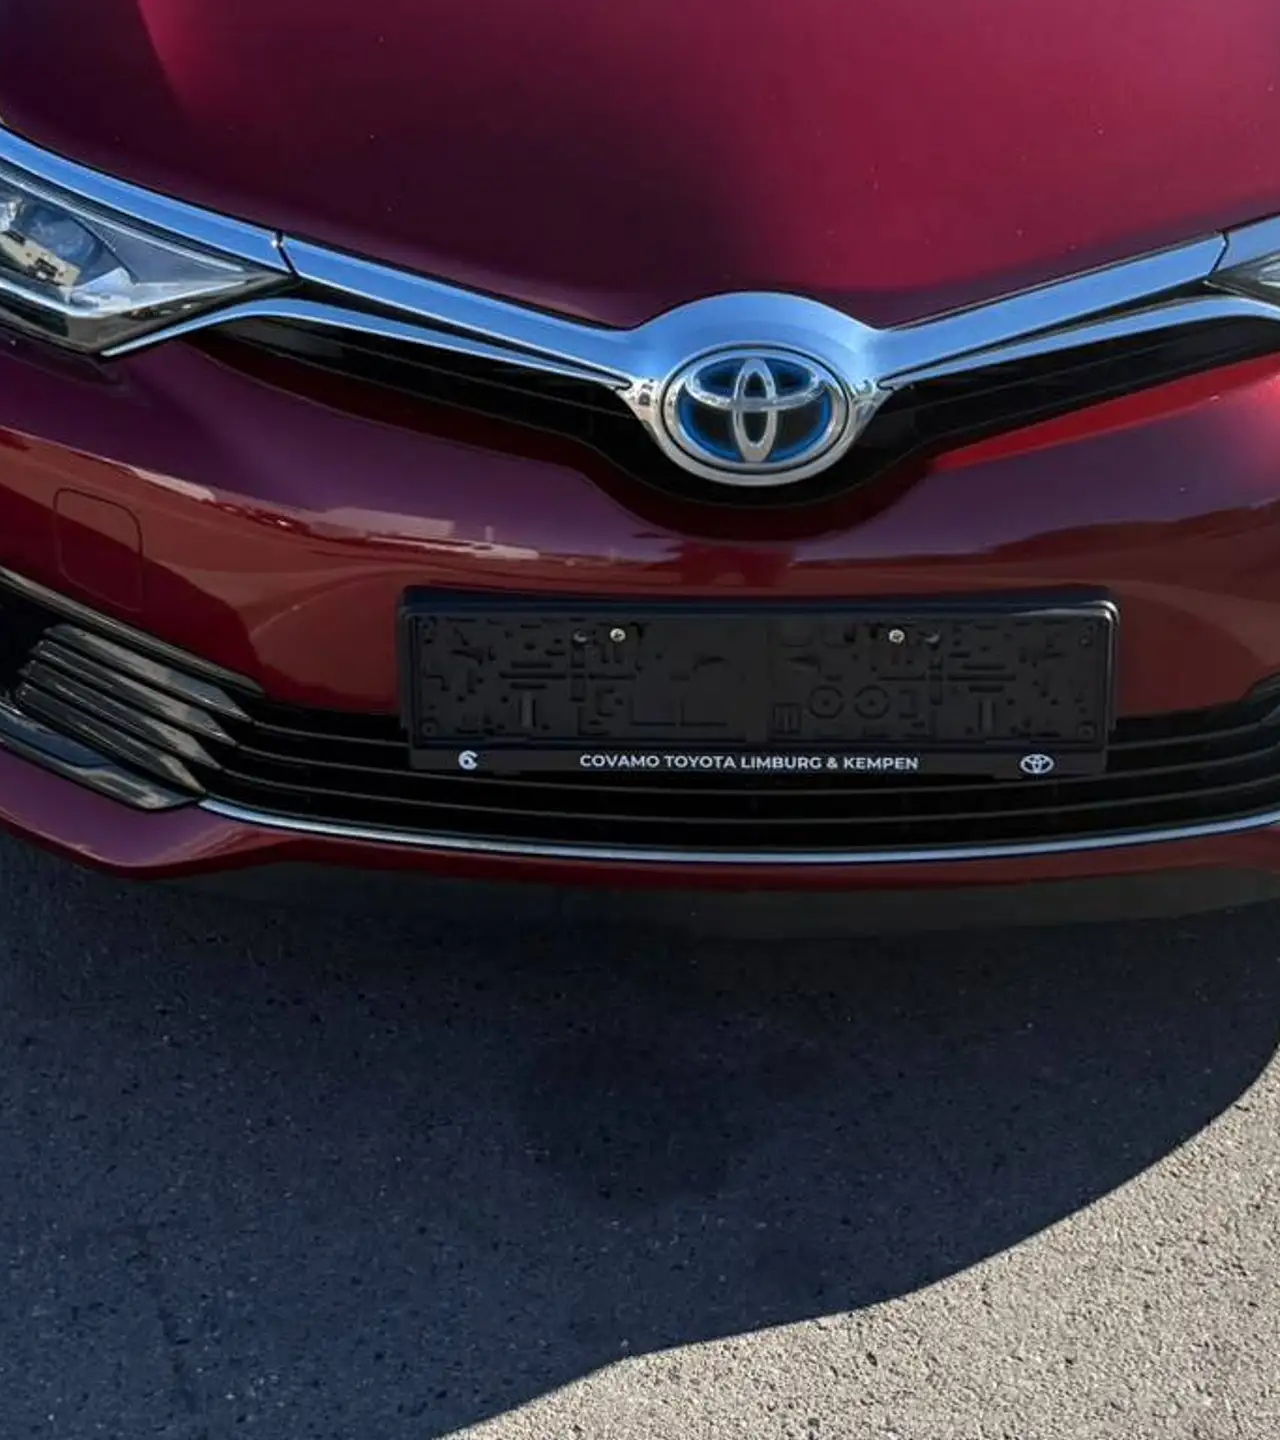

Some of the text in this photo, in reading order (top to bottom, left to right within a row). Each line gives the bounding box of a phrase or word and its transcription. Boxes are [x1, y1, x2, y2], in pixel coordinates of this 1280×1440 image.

[579, 754, 919, 770] COVAMO TOYOTA LIMBURG & KEMPEN
